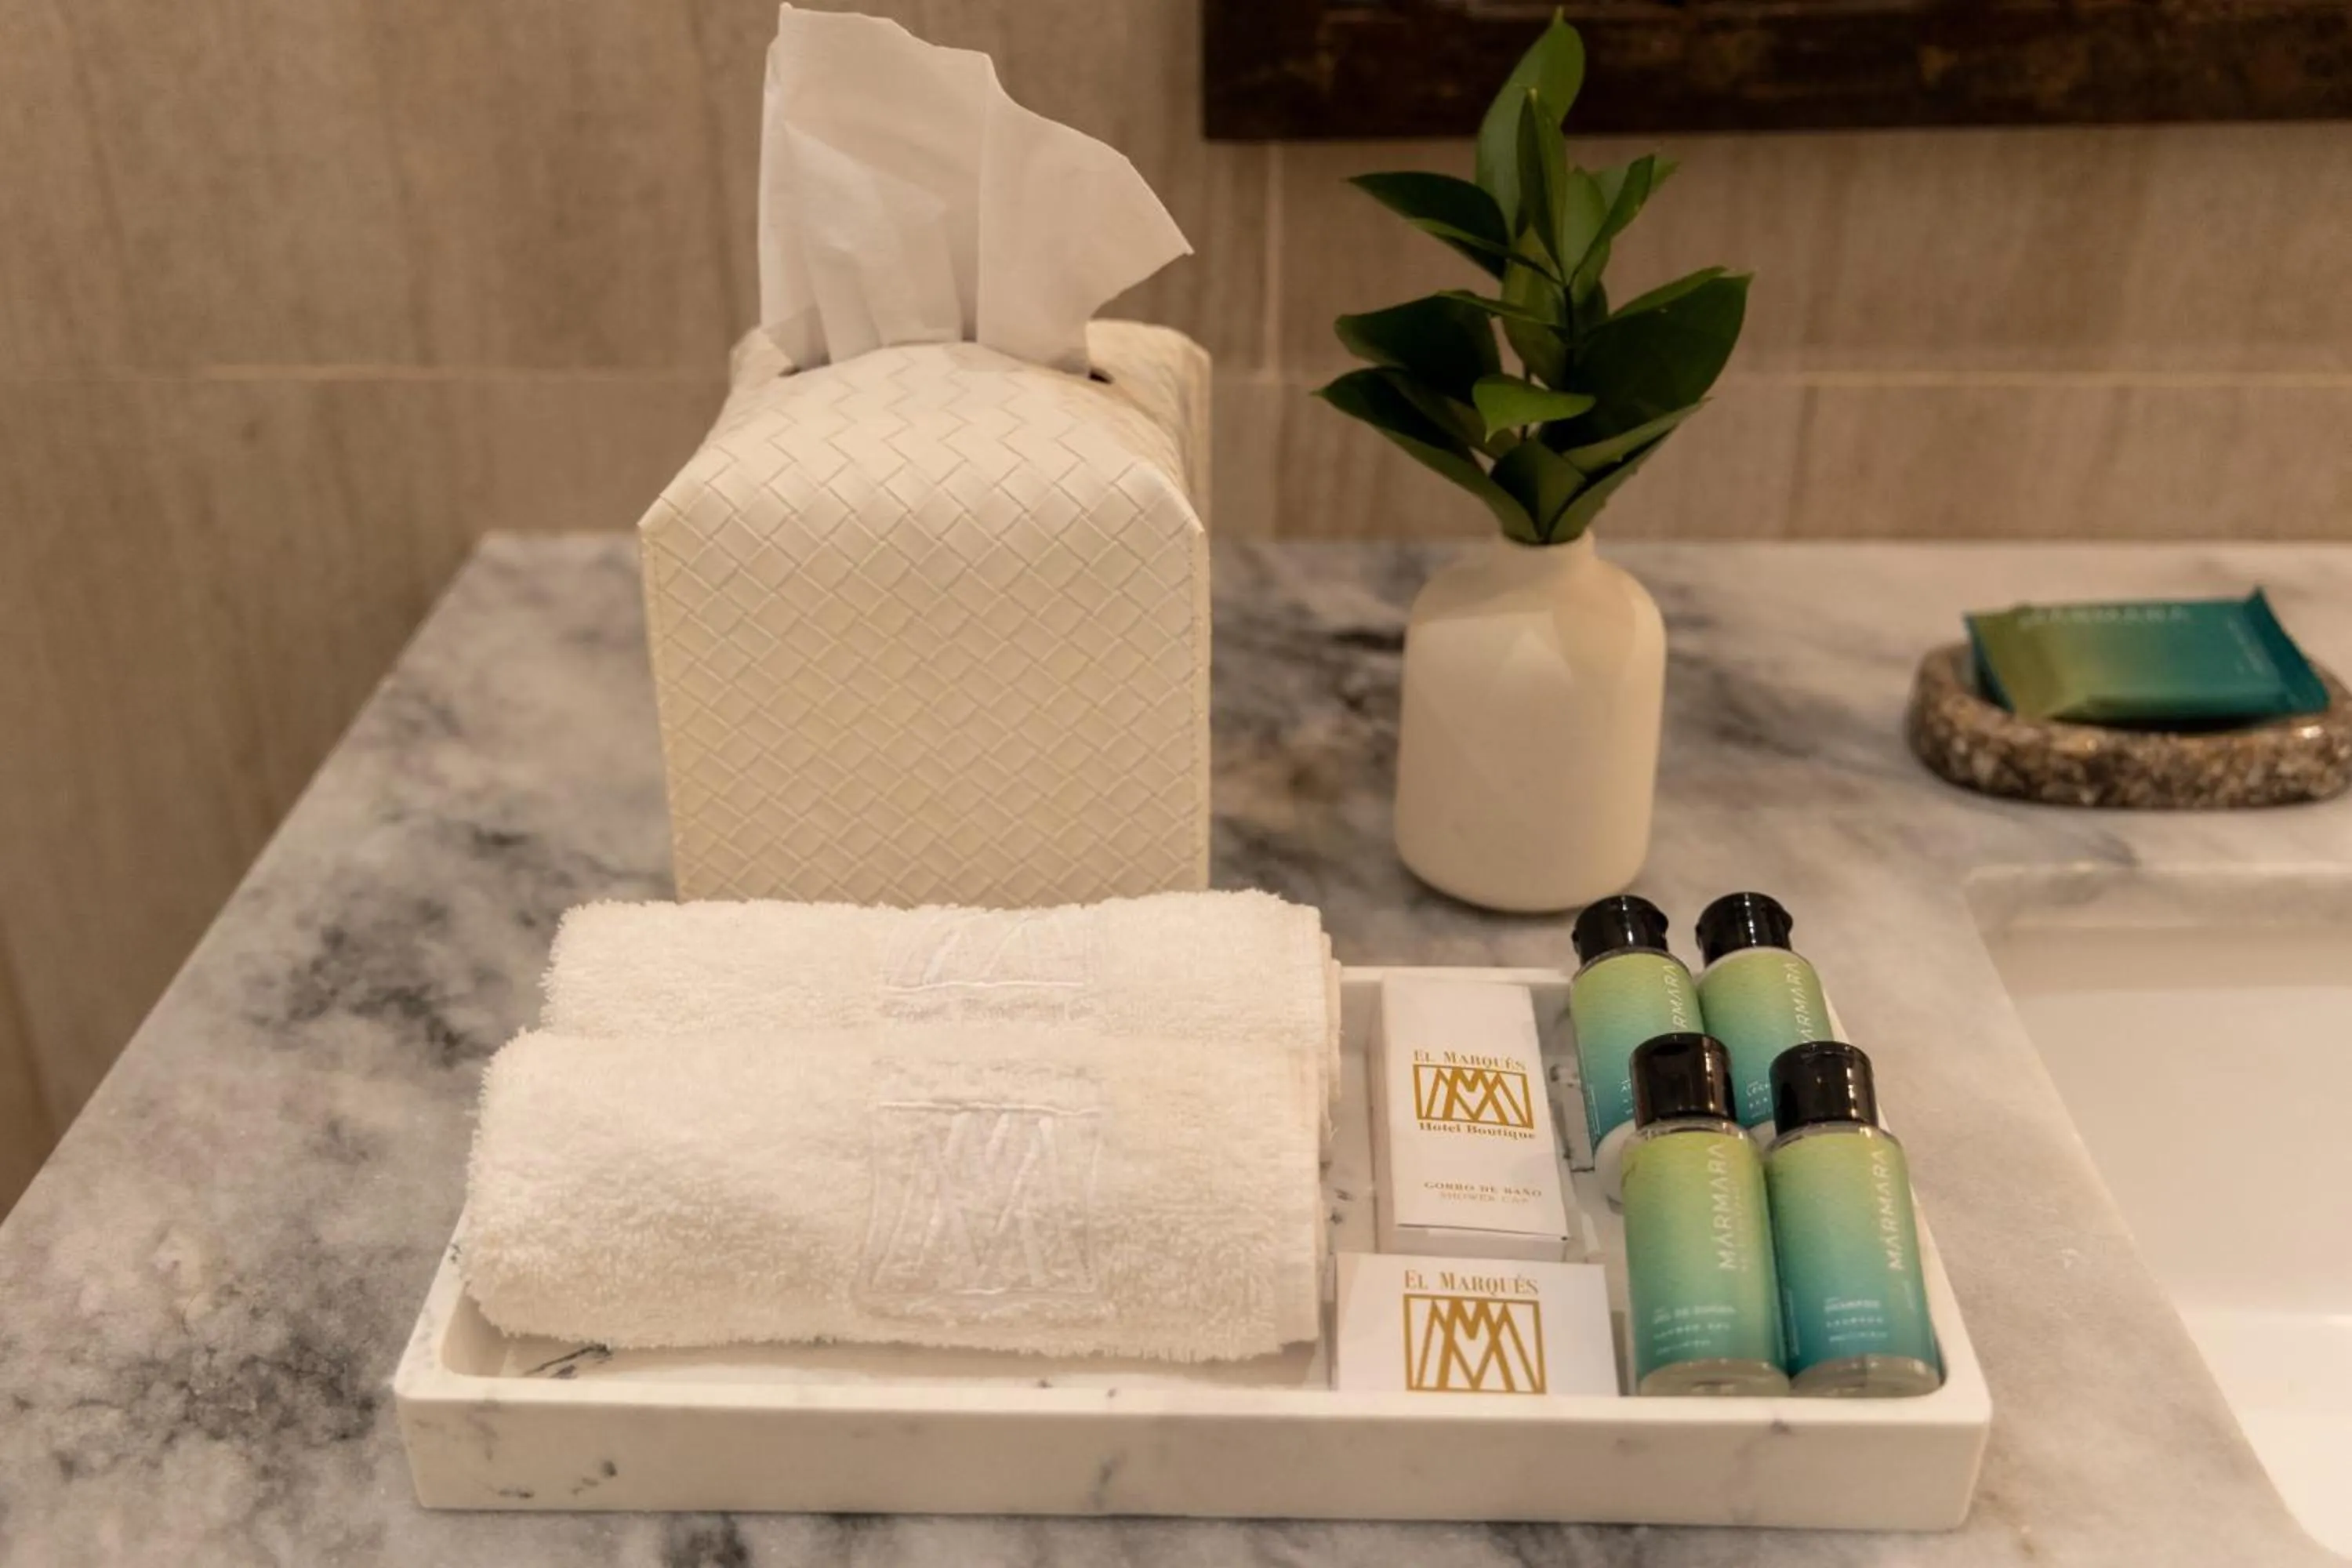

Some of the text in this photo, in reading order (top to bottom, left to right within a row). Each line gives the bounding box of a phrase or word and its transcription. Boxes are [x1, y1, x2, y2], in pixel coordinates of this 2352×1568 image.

[1663, 965, 1687, 1029] RMARA
[1784, 962, 1814, 1044] ARMARA
[1414, 1051, 1435, 1062] EL
[1419, 1122, 1535, 1139] Hotel Boutique
[1707, 1143, 1737, 1271] MARMARA
[1871, 1149, 1904, 1271] MARMARA
[1404, 1269, 1539, 1295] EL MARQUÉS
